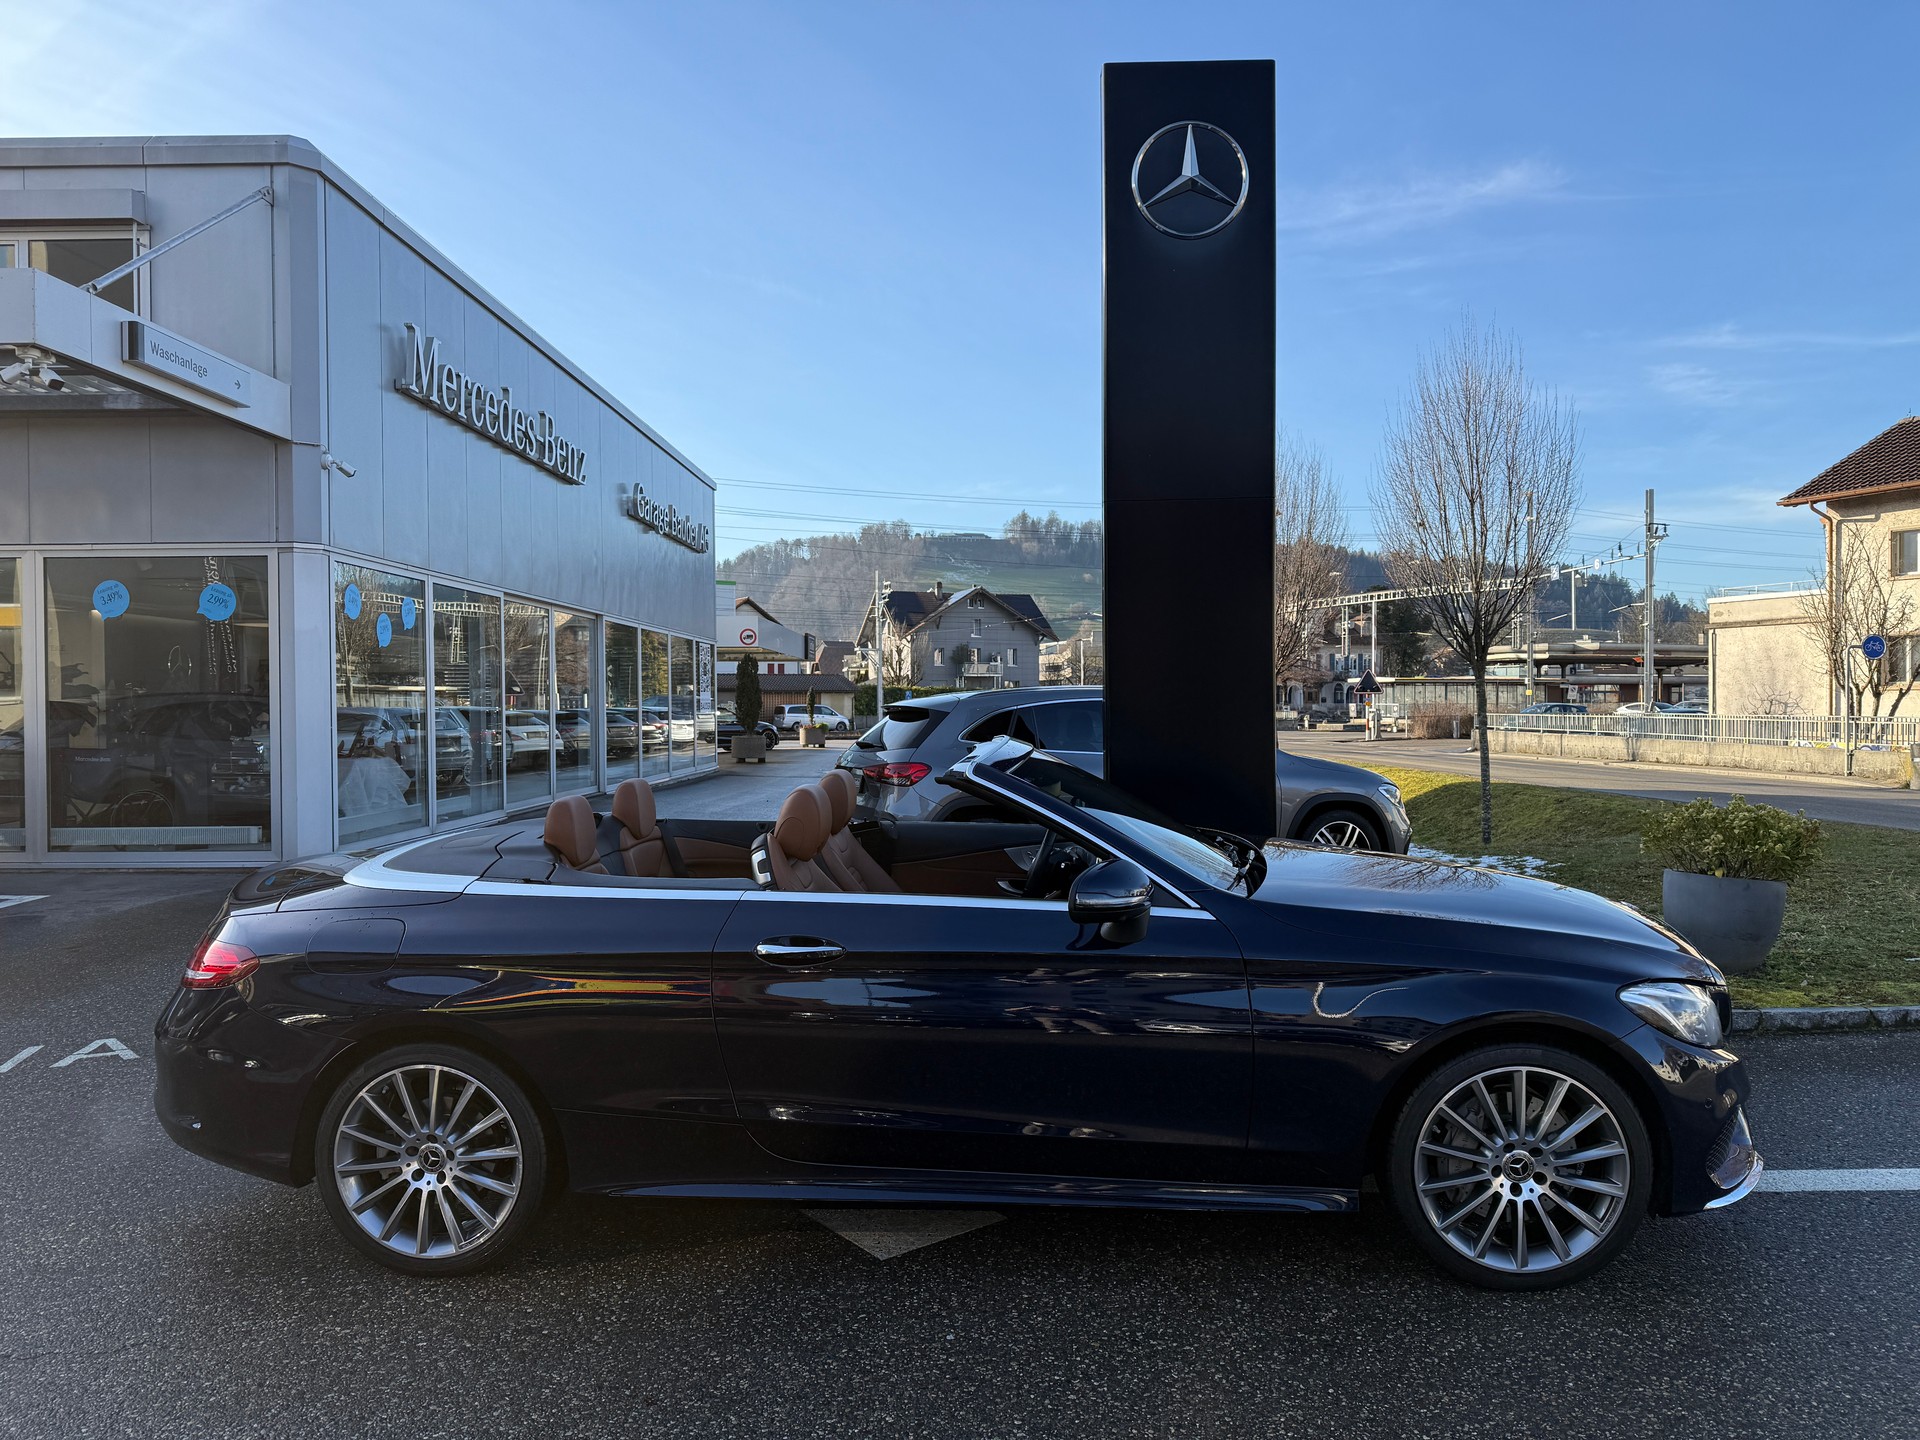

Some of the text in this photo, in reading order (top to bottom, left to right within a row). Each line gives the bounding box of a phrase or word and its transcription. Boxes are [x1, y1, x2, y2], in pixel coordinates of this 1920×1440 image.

[150, 340, 208, 378] Waschanlage
[403, 322, 588, 485] Mercedes-Benz
[634, 483, 670, 535] Garage
[100, 590, 122, 605] 3.49%
[207, 593, 229, 609] 2.99%
